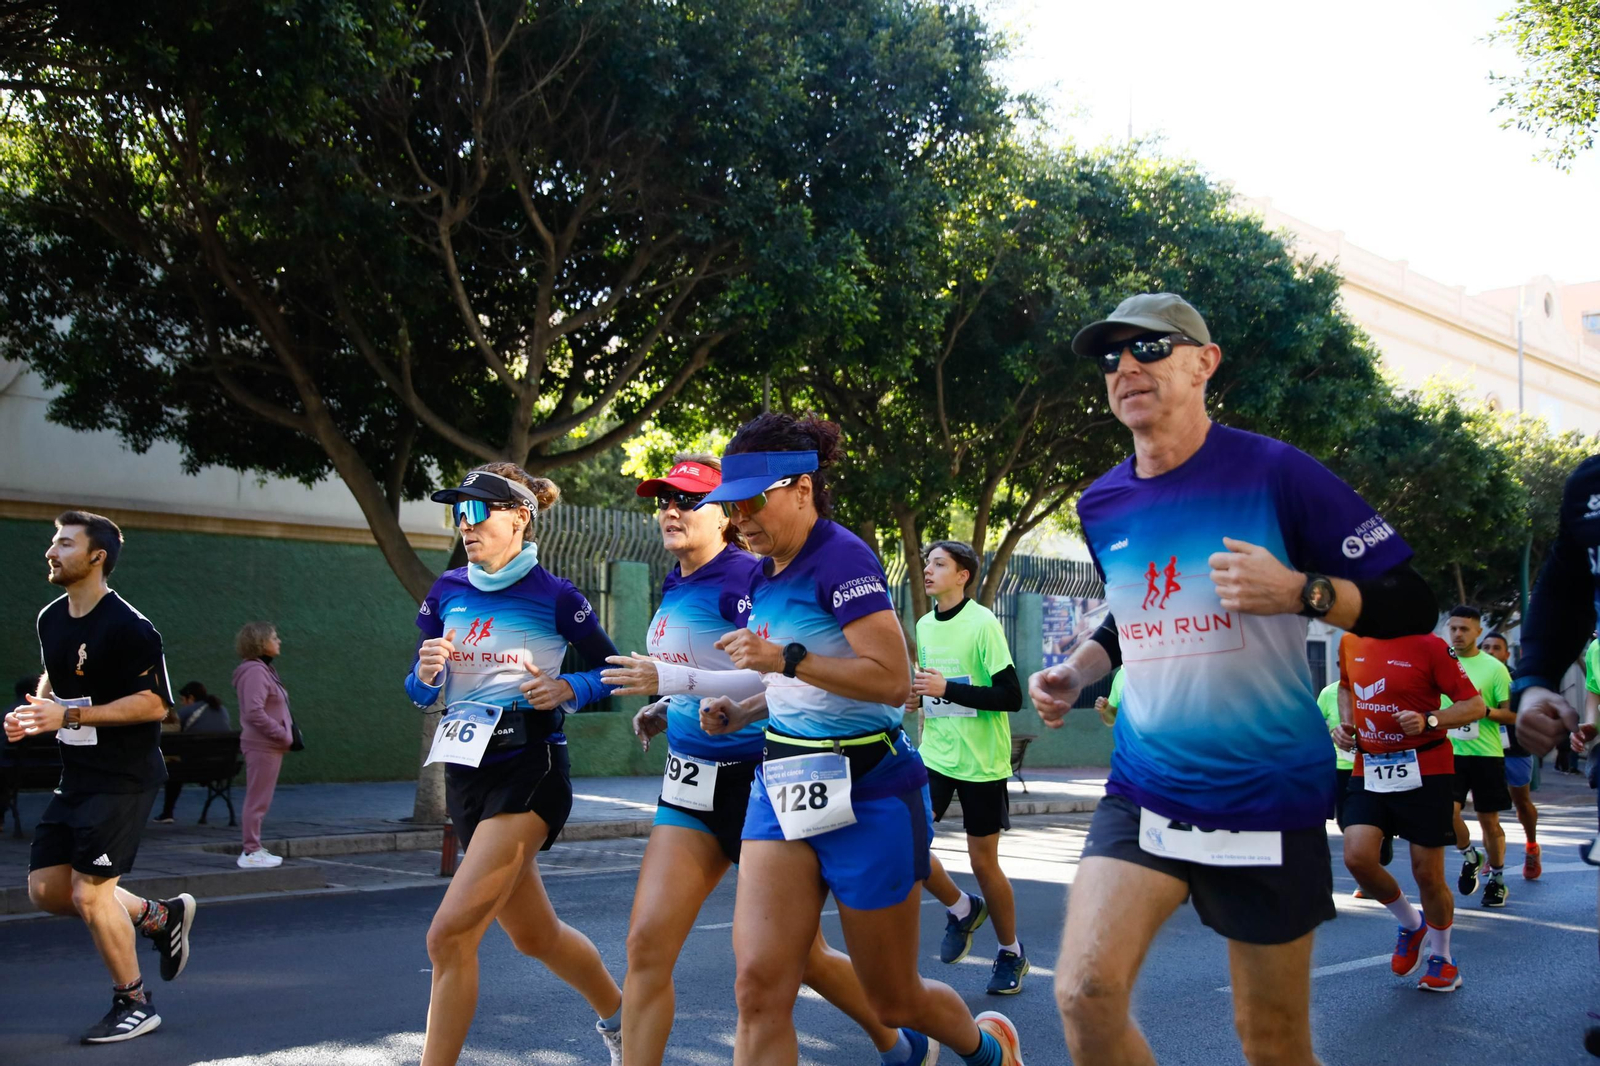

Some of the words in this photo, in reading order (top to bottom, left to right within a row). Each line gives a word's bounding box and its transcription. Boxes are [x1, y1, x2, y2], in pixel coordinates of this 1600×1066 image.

[1119, 620, 1162, 640] NEW
[1174, 612, 1231, 634] RUN
[481, 653, 518, 664] RUN
[1356, 700, 1399, 714] Europack
[1374, 764, 1408, 780] 175
[777, 781, 828, 813] 128
